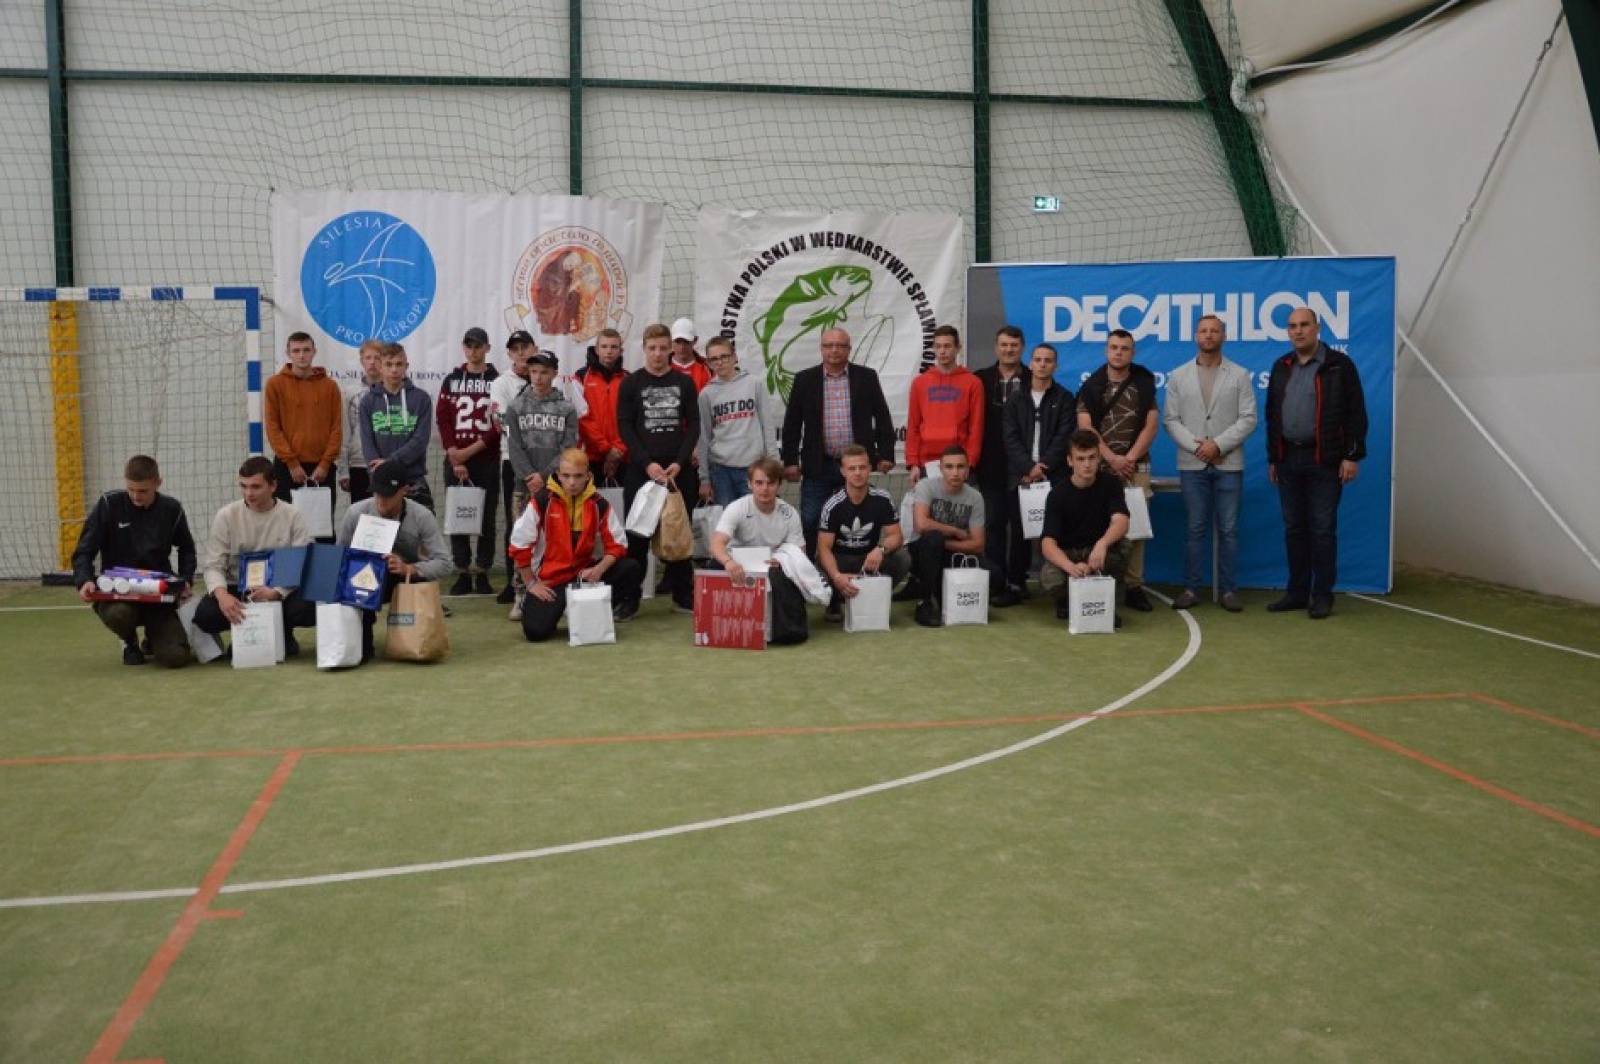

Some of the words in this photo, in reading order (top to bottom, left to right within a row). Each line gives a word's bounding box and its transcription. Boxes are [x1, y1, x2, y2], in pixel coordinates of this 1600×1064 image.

[319, 216, 383, 248] SILESIA
[720, 284, 750, 347] OSTWA
[740, 241, 790, 286] POLSKI
[789, 234, 807, 252] W
[809, 231, 914, 286] WĘDKARSTWIE
[335, 325, 364, 343] PRO
[382, 297, 429, 342] EUROPA
[1043, 291, 1350, 342] DECATHLON
[450, 379, 492, 393] WARRIO
[455, 395, 493, 431] 23
[712, 400, 736, 418] JUST
[737, 398, 755, 410] DO
[518, 413, 566, 432] ROCKED
[957, 591, 980, 600] SPOT
[1081, 601, 1106, 609] SPOT
[1081, 609, 1106, 617] LIGHT
